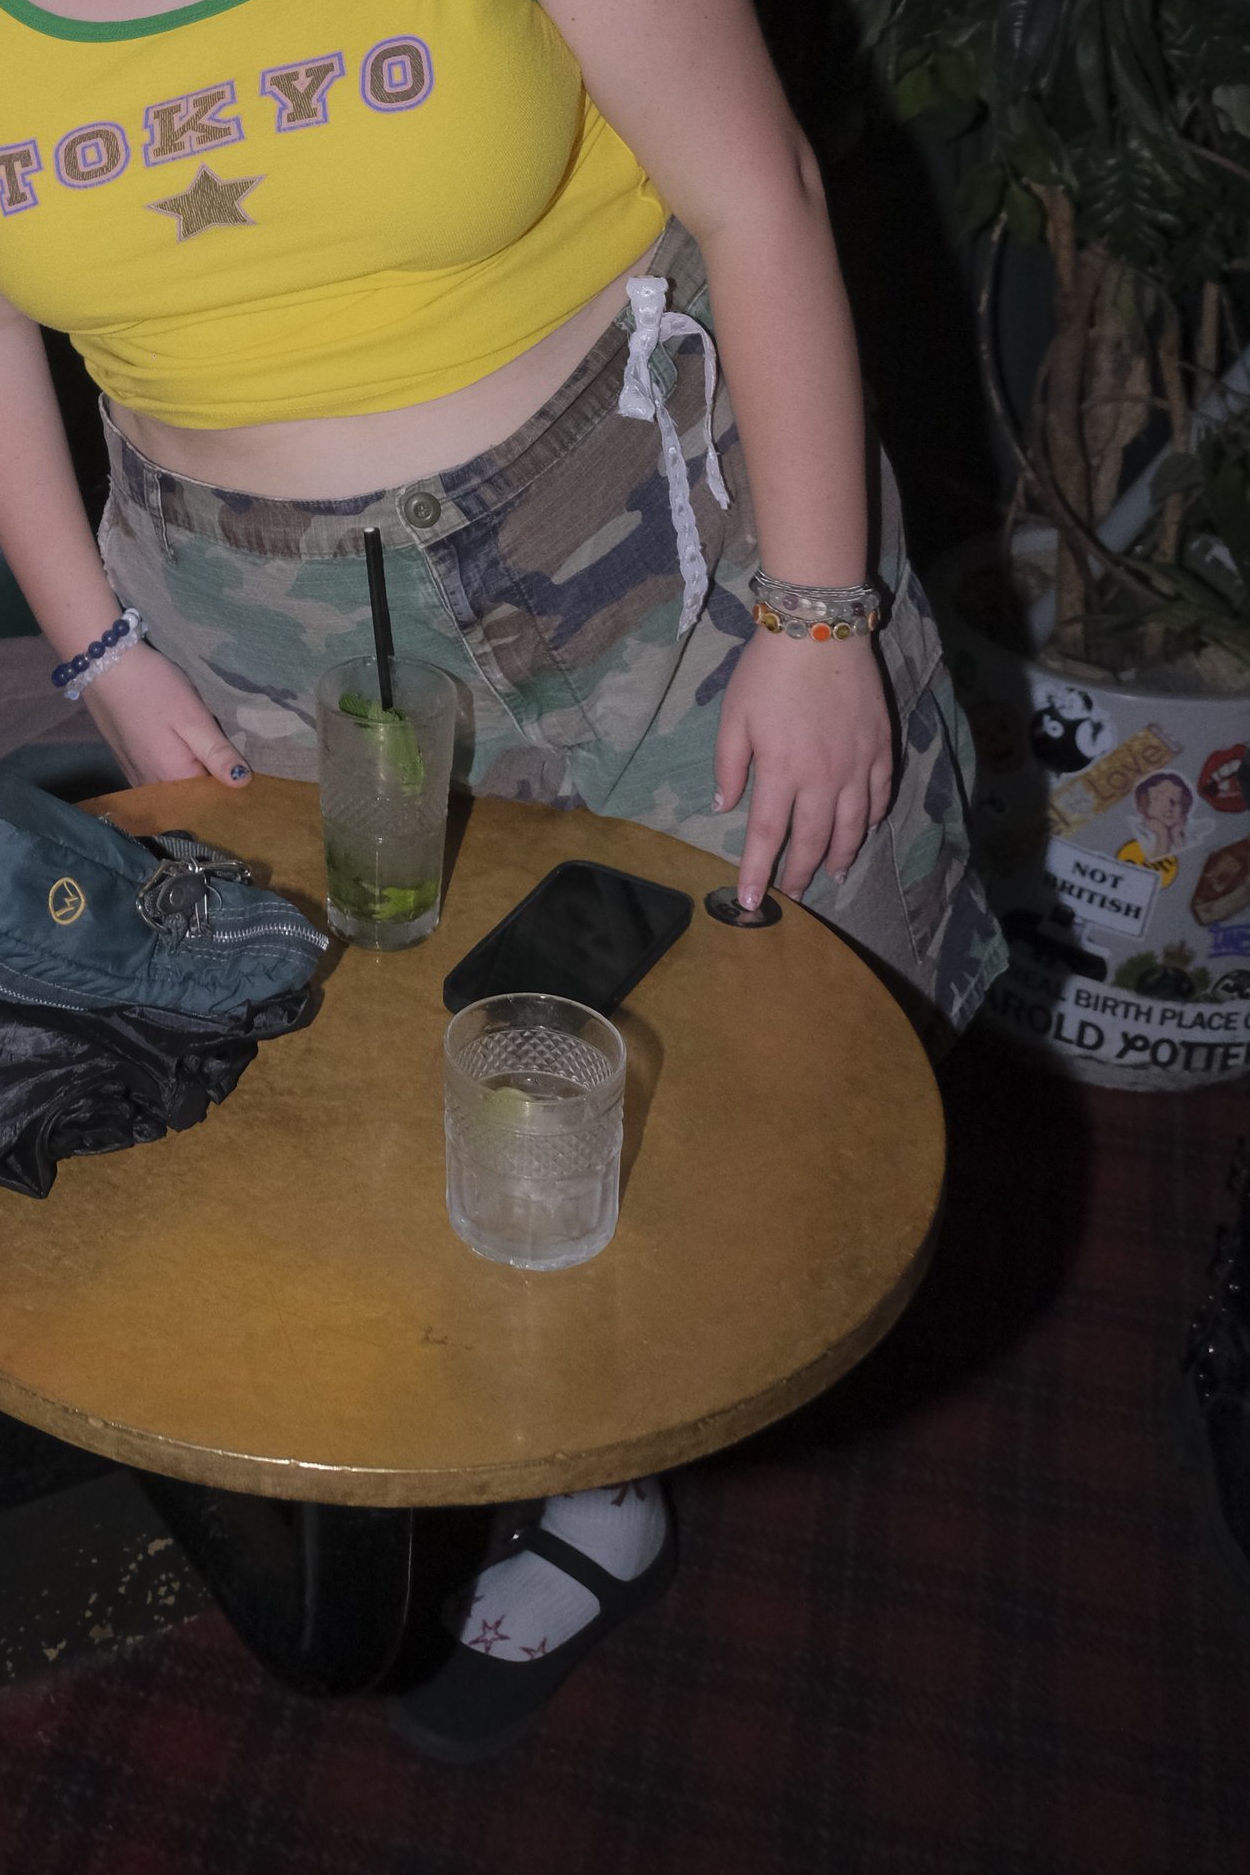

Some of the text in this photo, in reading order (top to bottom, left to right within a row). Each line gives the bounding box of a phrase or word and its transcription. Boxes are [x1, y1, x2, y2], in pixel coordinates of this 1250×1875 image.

[1086, 744, 1165, 803] Love
[1072, 861, 1123, 888] NOT
[1074, 988, 1152, 1024] BIRTH
[1160, 1007, 1239, 1031] PLACE
